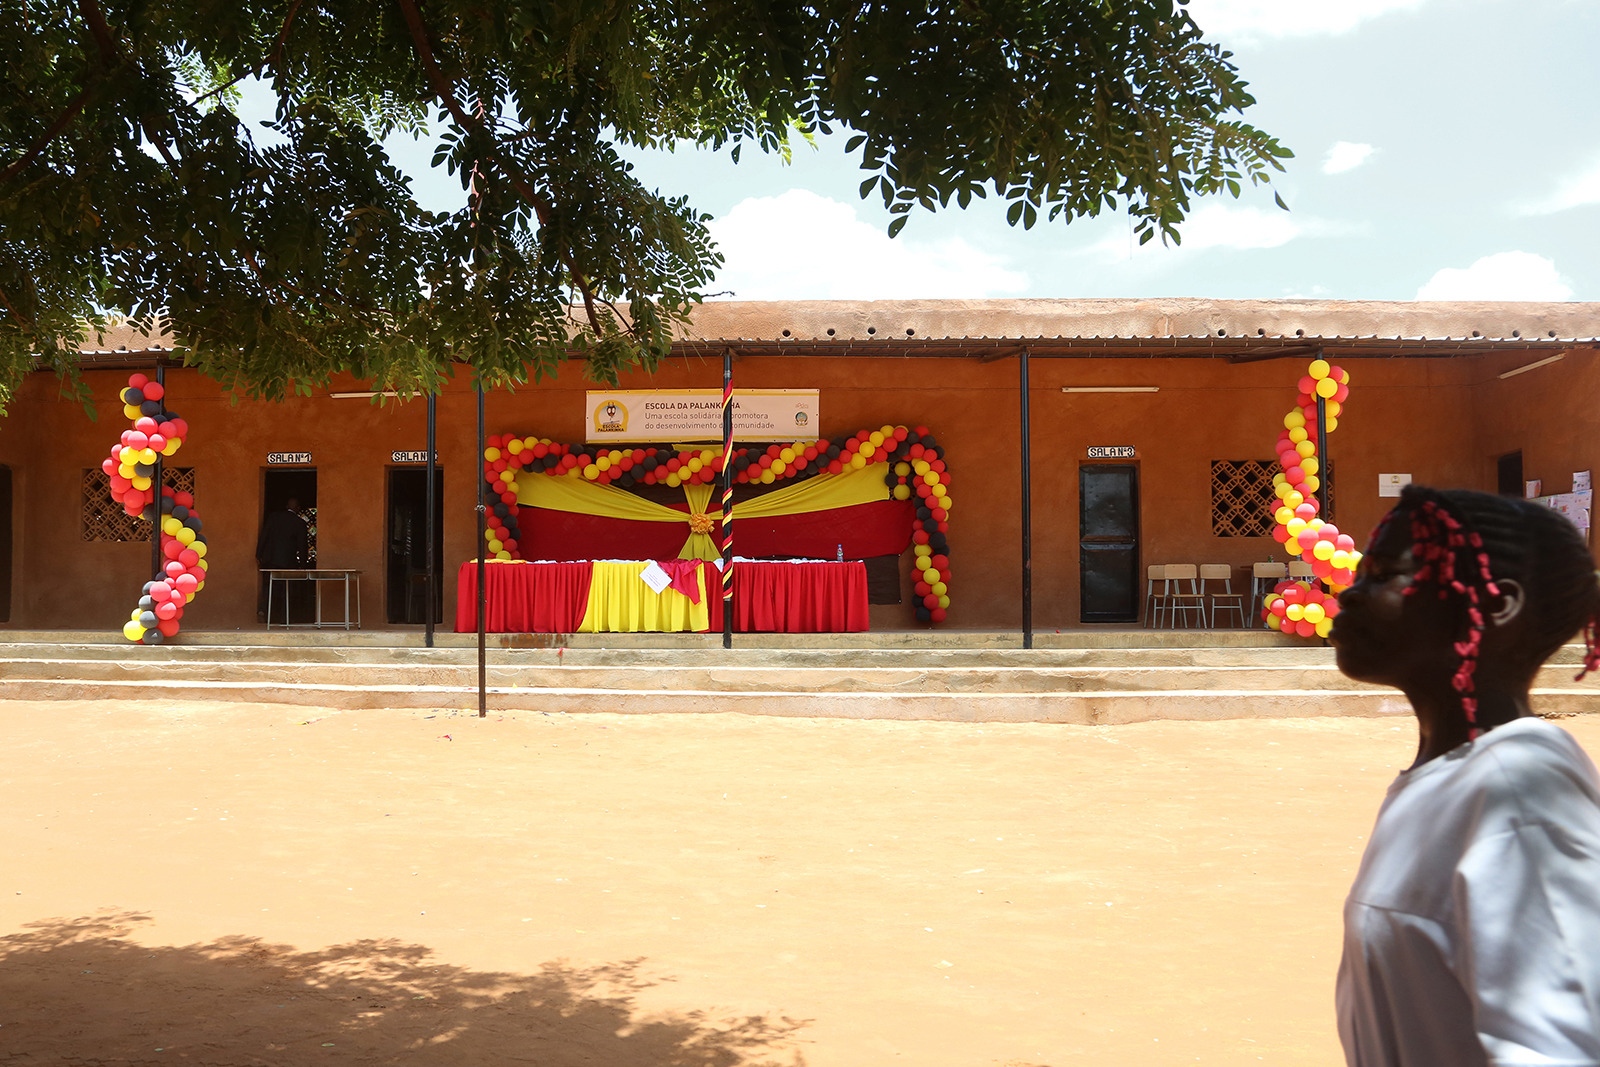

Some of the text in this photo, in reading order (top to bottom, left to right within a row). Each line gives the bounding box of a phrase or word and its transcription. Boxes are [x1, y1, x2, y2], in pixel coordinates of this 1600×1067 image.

[645, 402, 676, 410] ESCOLA
[677, 402, 689, 410] DA
[644, 412, 663, 420] Uma
[664, 412, 688, 420] escola
[689, 411, 722, 420] solidária
[644, 422, 654, 430] do
[655, 422, 717, 430] desenvolvimento
[729, 422, 775, 430] omunidade
[394, 452, 419, 461] SALA
[1090, 447, 1116, 457] SALA
[269, 453, 294, 463] SALA
